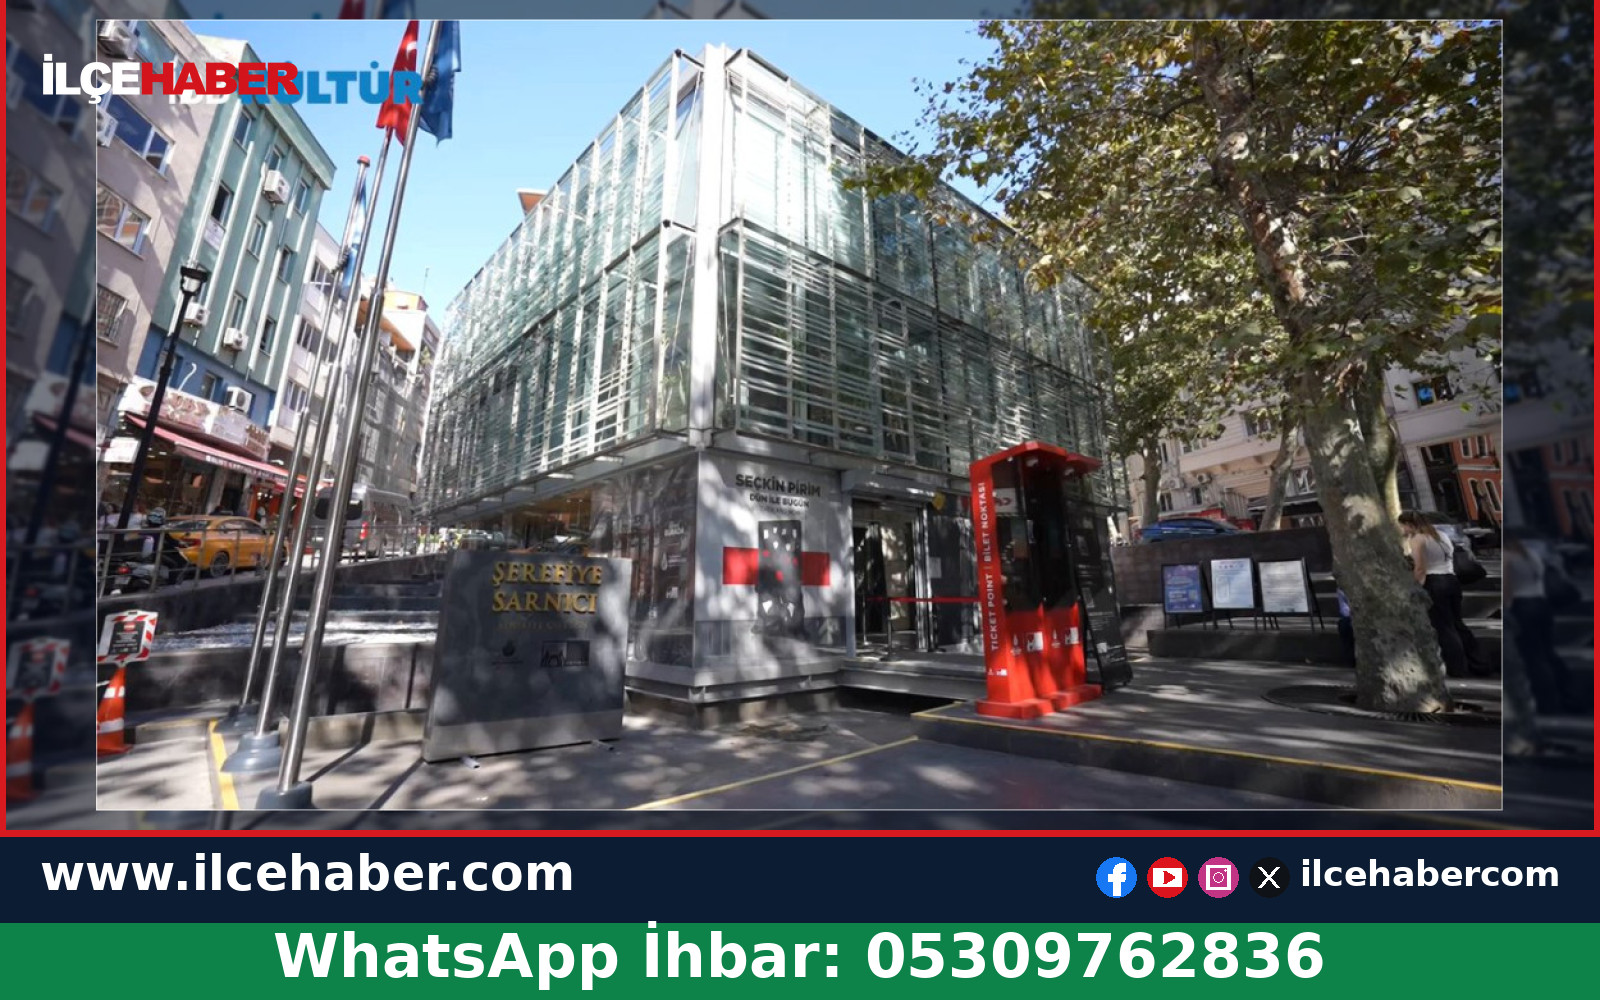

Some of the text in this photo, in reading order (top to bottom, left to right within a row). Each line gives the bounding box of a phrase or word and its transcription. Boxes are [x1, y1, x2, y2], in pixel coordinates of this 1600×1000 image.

[735, 473, 821, 497] SEÇKİN PİRİM
[492, 560, 603, 588] ŞEREFİYE
[977, 482, 999, 651] TICKET POINT BİLET NOKTASI
[492, 590, 598, 614] SARNICI
